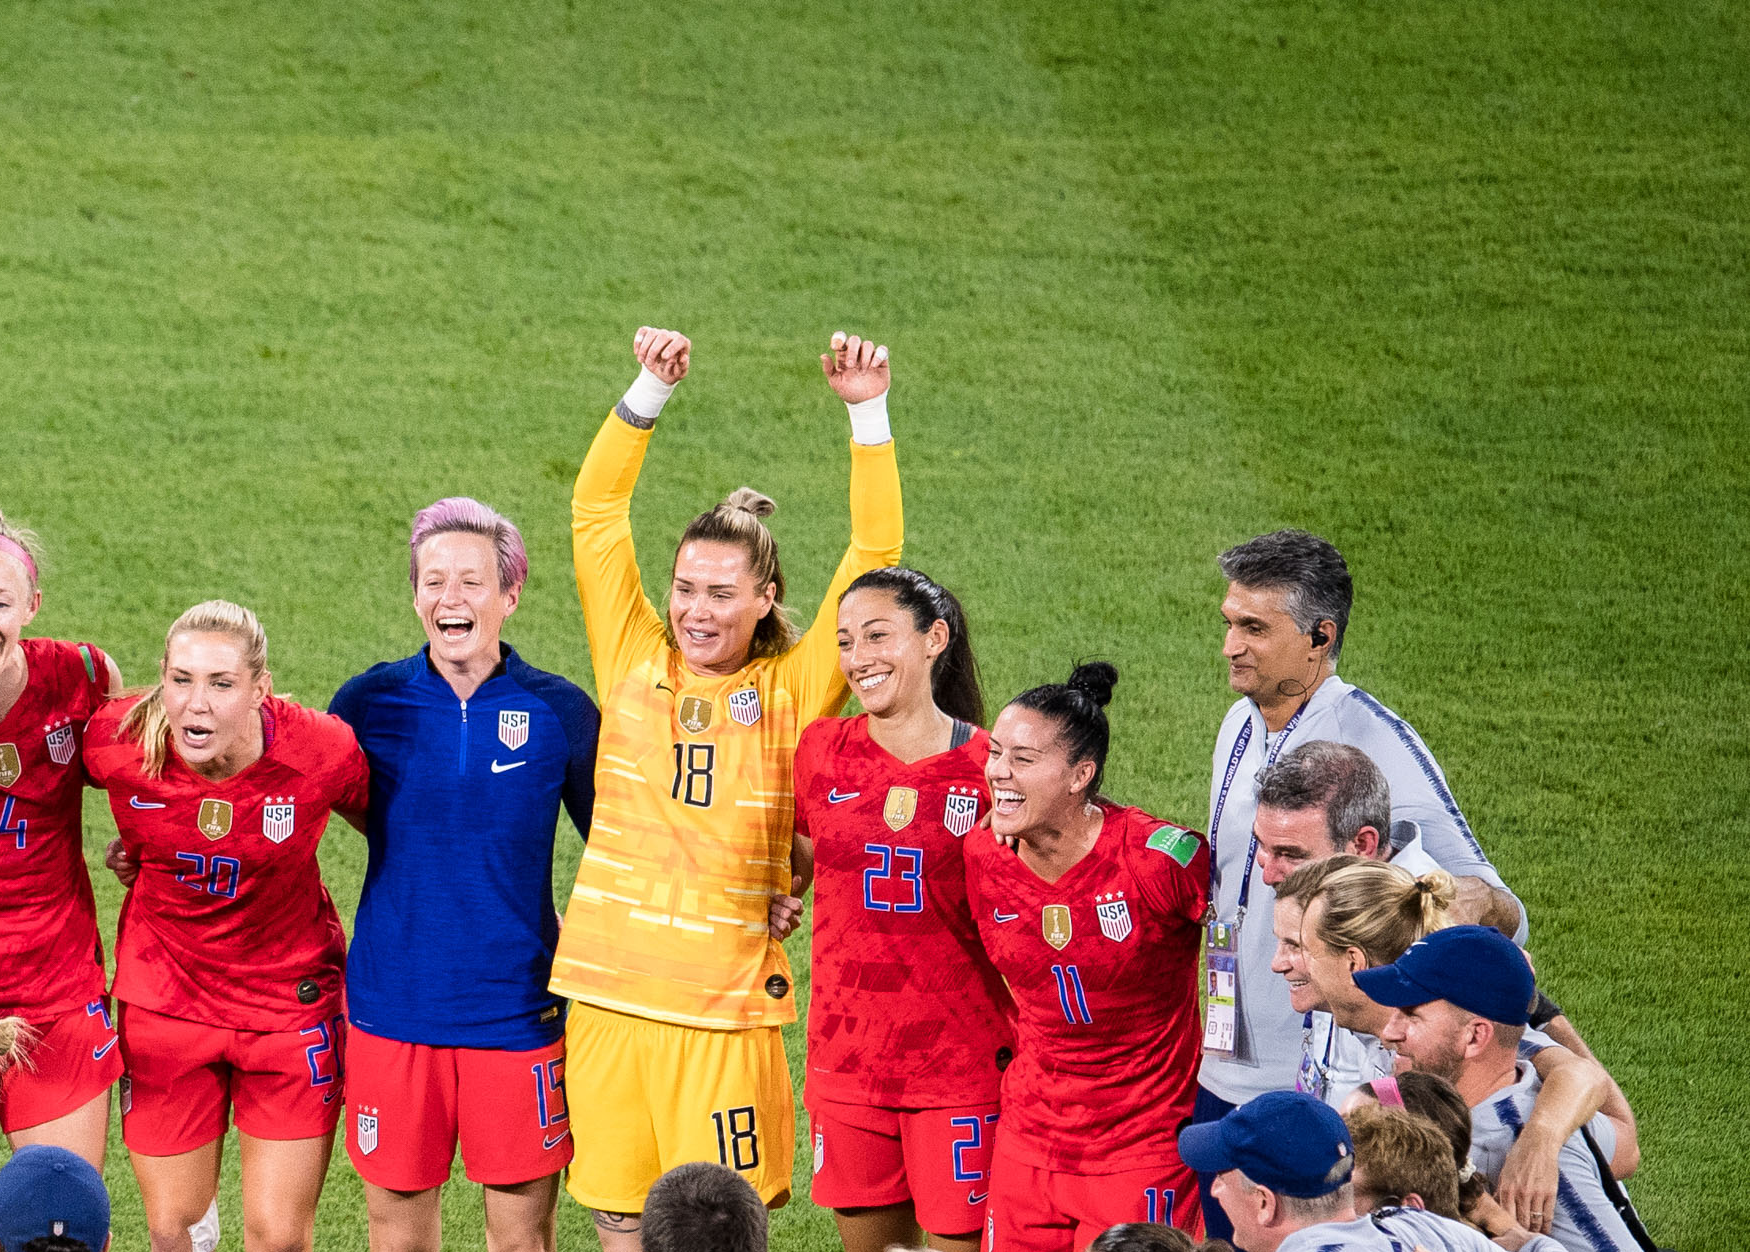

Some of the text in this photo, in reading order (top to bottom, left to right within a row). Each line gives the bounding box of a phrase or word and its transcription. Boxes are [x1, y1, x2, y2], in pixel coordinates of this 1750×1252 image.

[731, 691, 756, 705] USA
[49, 727, 71, 745] USA
[502, 713, 528, 727] USA
[671, 742, 716, 809] 18
[1223, 757, 1238, 789] WORLD
[1235, 738, 1246, 757] CUP
[266, 807, 292, 821] USA
[949, 796, 975, 814] USA
[176, 850, 240, 899] 20
[863, 843, 923, 913] 23
[1100, 903, 1126, 920] USA
[1051, 965, 1093, 1024] 11
[532, 1057, 569, 1128] 15
[358, 1118, 377, 1132] USA
[711, 1105, 760, 1171] 18
